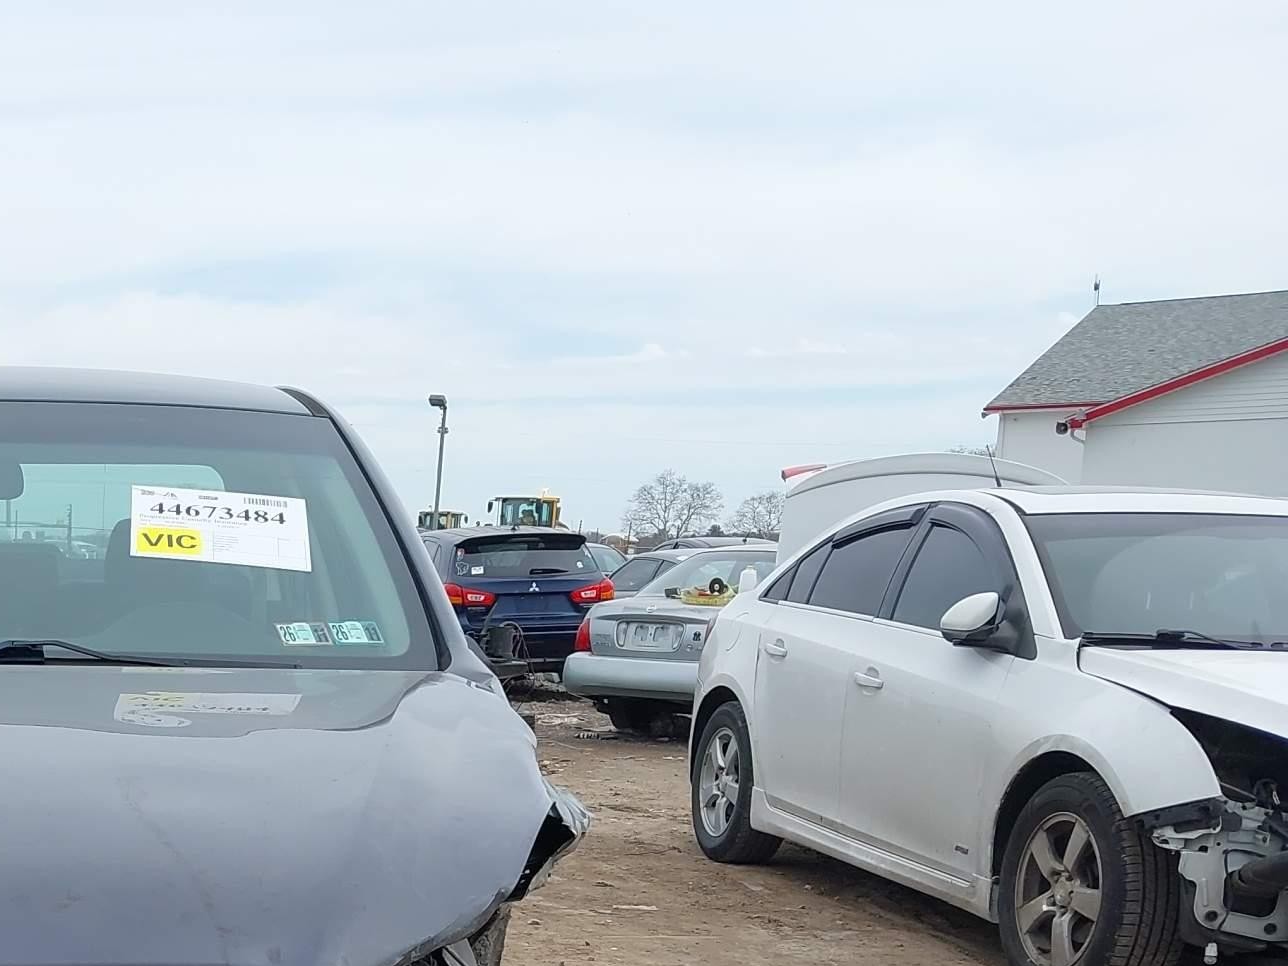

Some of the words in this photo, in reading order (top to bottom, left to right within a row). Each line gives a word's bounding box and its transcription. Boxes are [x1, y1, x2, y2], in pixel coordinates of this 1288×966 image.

[150, 502, 286, 525] 44673484
[142, 532, 198, 549] VIC
[280, 625, 297, 642] 26
[332, 624, 349, 641] 26
